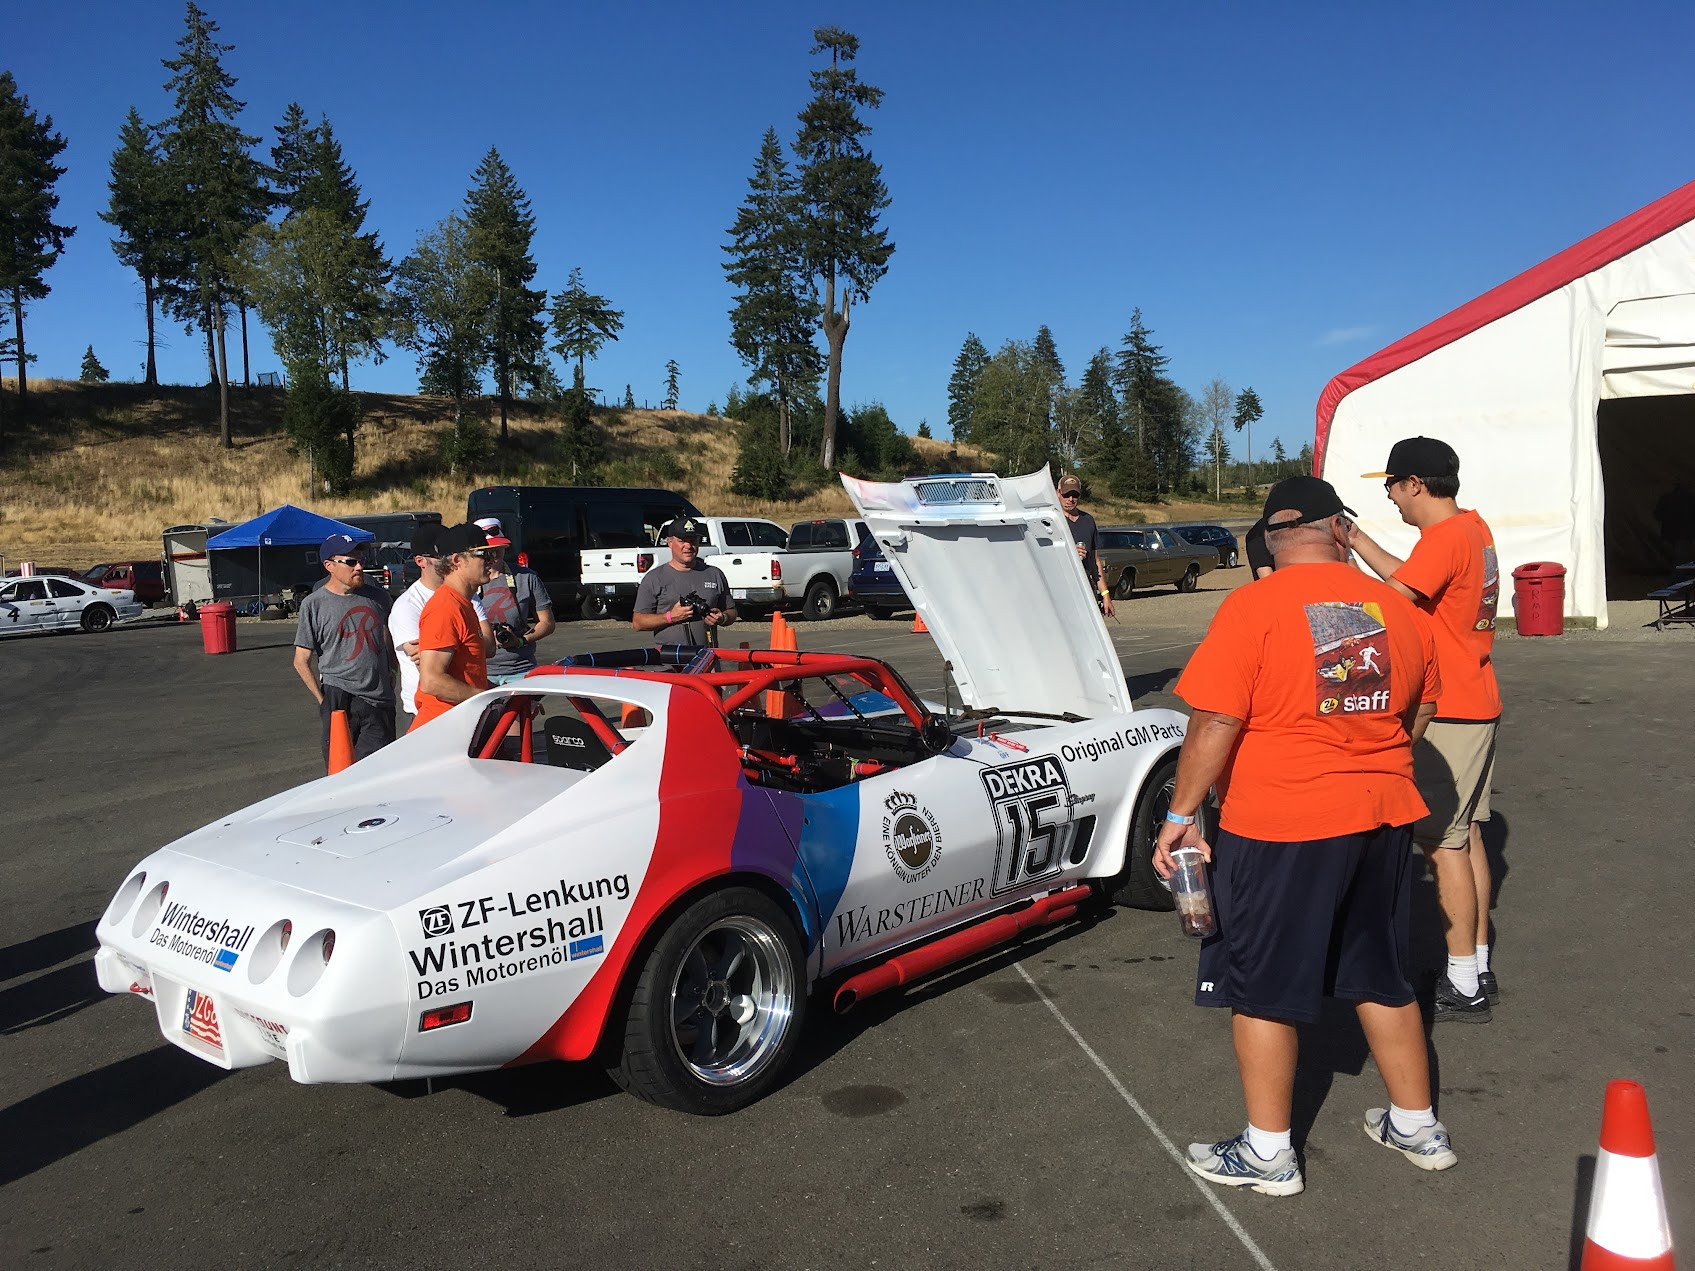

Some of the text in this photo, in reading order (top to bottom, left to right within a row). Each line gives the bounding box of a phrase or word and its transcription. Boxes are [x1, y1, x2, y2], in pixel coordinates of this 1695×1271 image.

[7, 607, 20, 622] 4
[1343, 690, 1389, 712] staff
[552, 735, 585, 746] sparco
[1061, 723, 1184, 762] Original GM Parts
[985, 761, 1063, 799] DEKRA
[882, 806, 942, 884] EINE KÖNIGIN UNTER DEN BIEREN
[1004, 792, 1060, 885] 15
[457, 874, 630, 929] ZF-Lenkung
[836, 877, 985, 948] WARSTEINER
[161, 901, 255, 952] Wintershall
[409, 905, 604, 977] Wintershall
[427, 913, 447, 931] ZF
[150, 927, 169, 948] Das
[168, 934, 219, 965] Motorenöl
[417, 945, 568, 1000] Das Motorenöl
[1200, 981, 1215, 992] R
